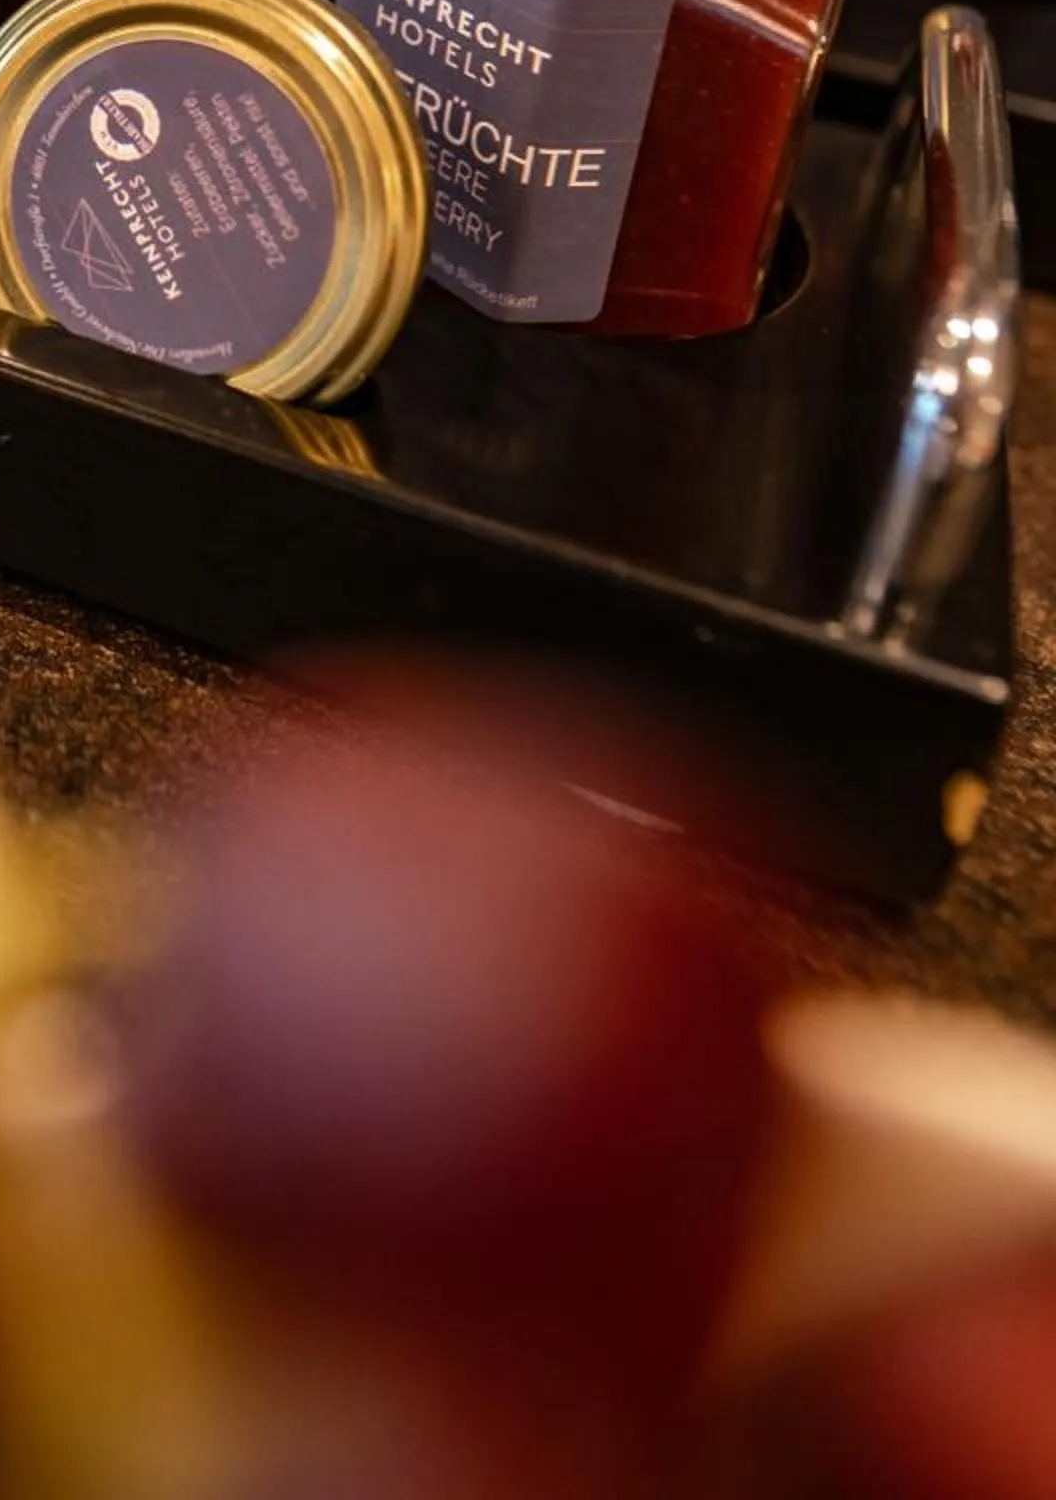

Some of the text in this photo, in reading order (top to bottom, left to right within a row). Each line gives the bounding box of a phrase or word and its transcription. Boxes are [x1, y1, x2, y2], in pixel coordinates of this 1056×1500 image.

[375, 4, 497, 88] HOTELS
[95, 160, 183, 301] KEINPRECHT
[128, 174, 186, 263] HOTELS
